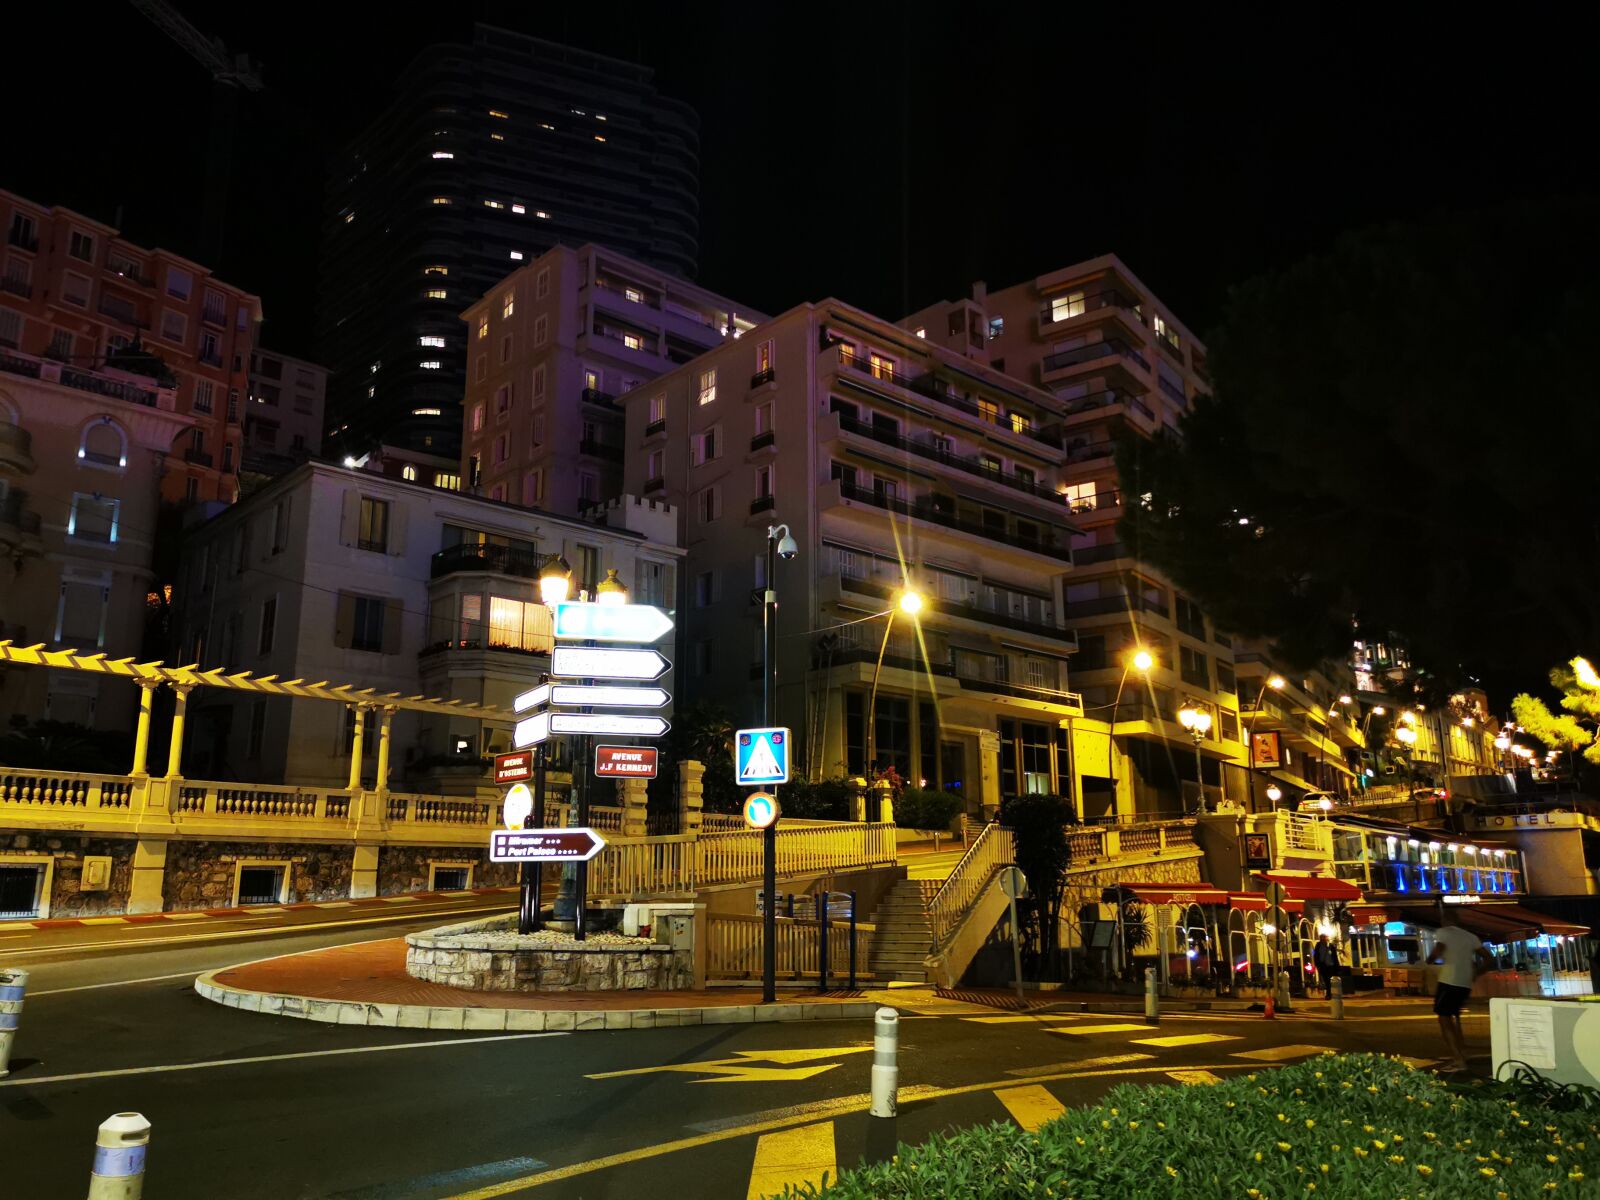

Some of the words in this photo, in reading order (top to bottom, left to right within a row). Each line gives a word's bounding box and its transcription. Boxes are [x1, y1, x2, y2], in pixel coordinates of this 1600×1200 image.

[611, 752, 643, 762] AVENUE
[599, 762, 614, 771] J.F
[615, 763, 653, 772] KENNEDY
[1475, 814, 1555, 827] HOTEL
